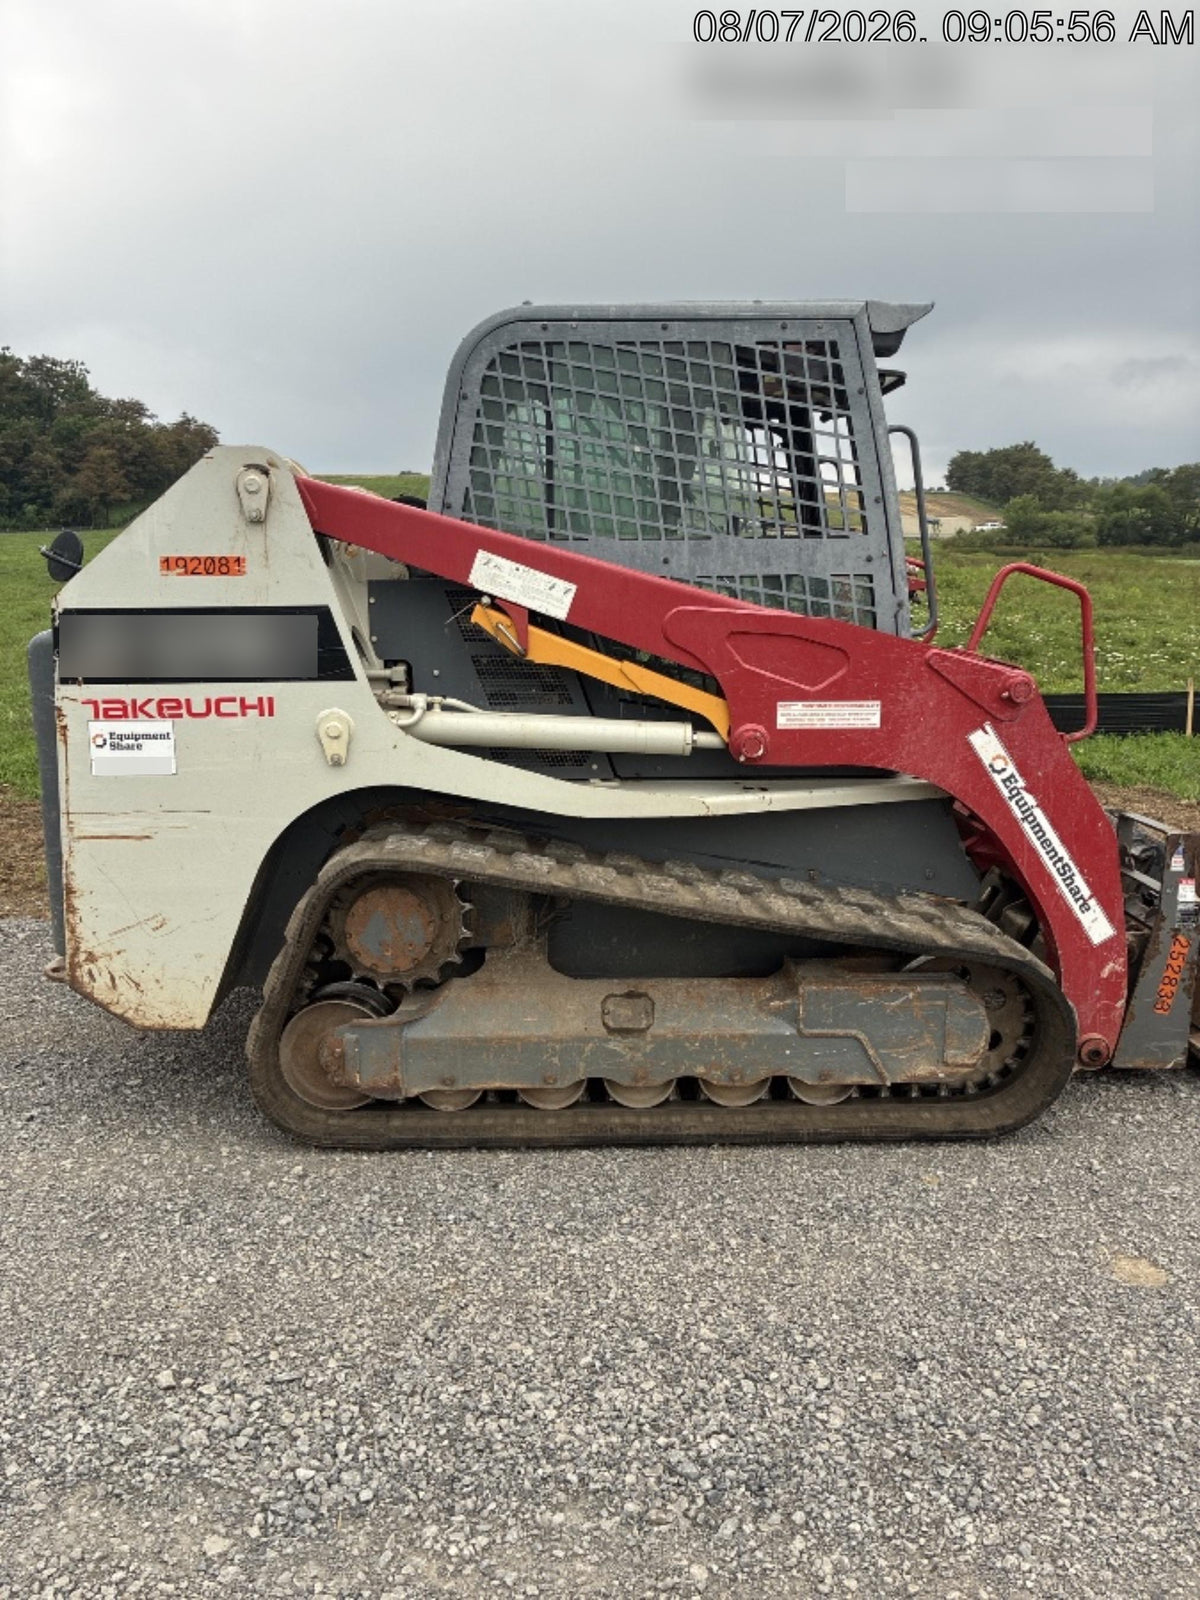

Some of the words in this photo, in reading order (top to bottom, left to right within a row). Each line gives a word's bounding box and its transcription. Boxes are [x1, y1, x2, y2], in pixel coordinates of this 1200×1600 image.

[162, 556, 241, 575] 192081
[109, 732, 171, 741] Equipment
[109, 741, 143, 751] Share
[1001, 772, 1092, 914] EquipmentShare
